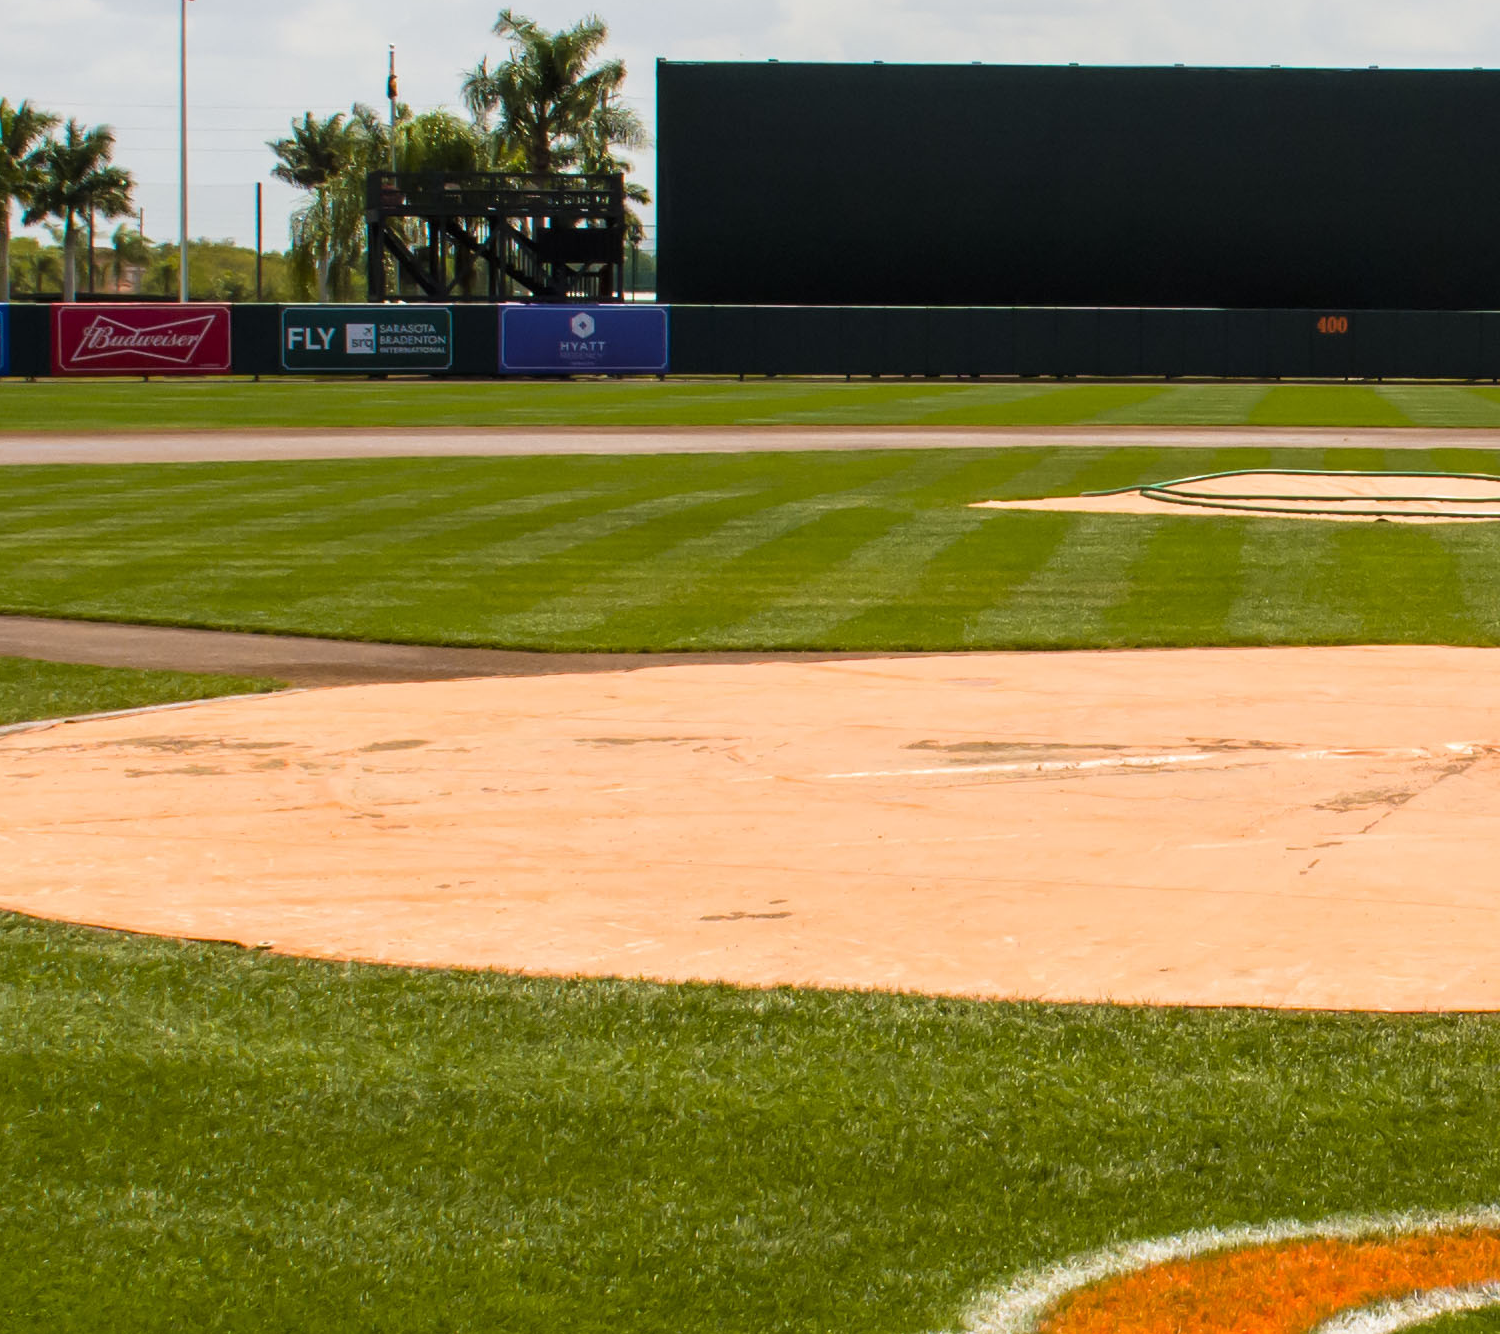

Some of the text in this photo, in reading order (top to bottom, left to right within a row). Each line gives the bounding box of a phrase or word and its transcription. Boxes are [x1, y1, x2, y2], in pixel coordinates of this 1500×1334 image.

[380, 324, 436, 334] SARASOTA
[1317, 316, 1348, 333] 400
[83, 326, 200, 348] Budweiser
[287, 328, 335, 350] FLY
[380, 335, 447, 345] BRADENTON
[560, 341, 605, 351] HYATT
